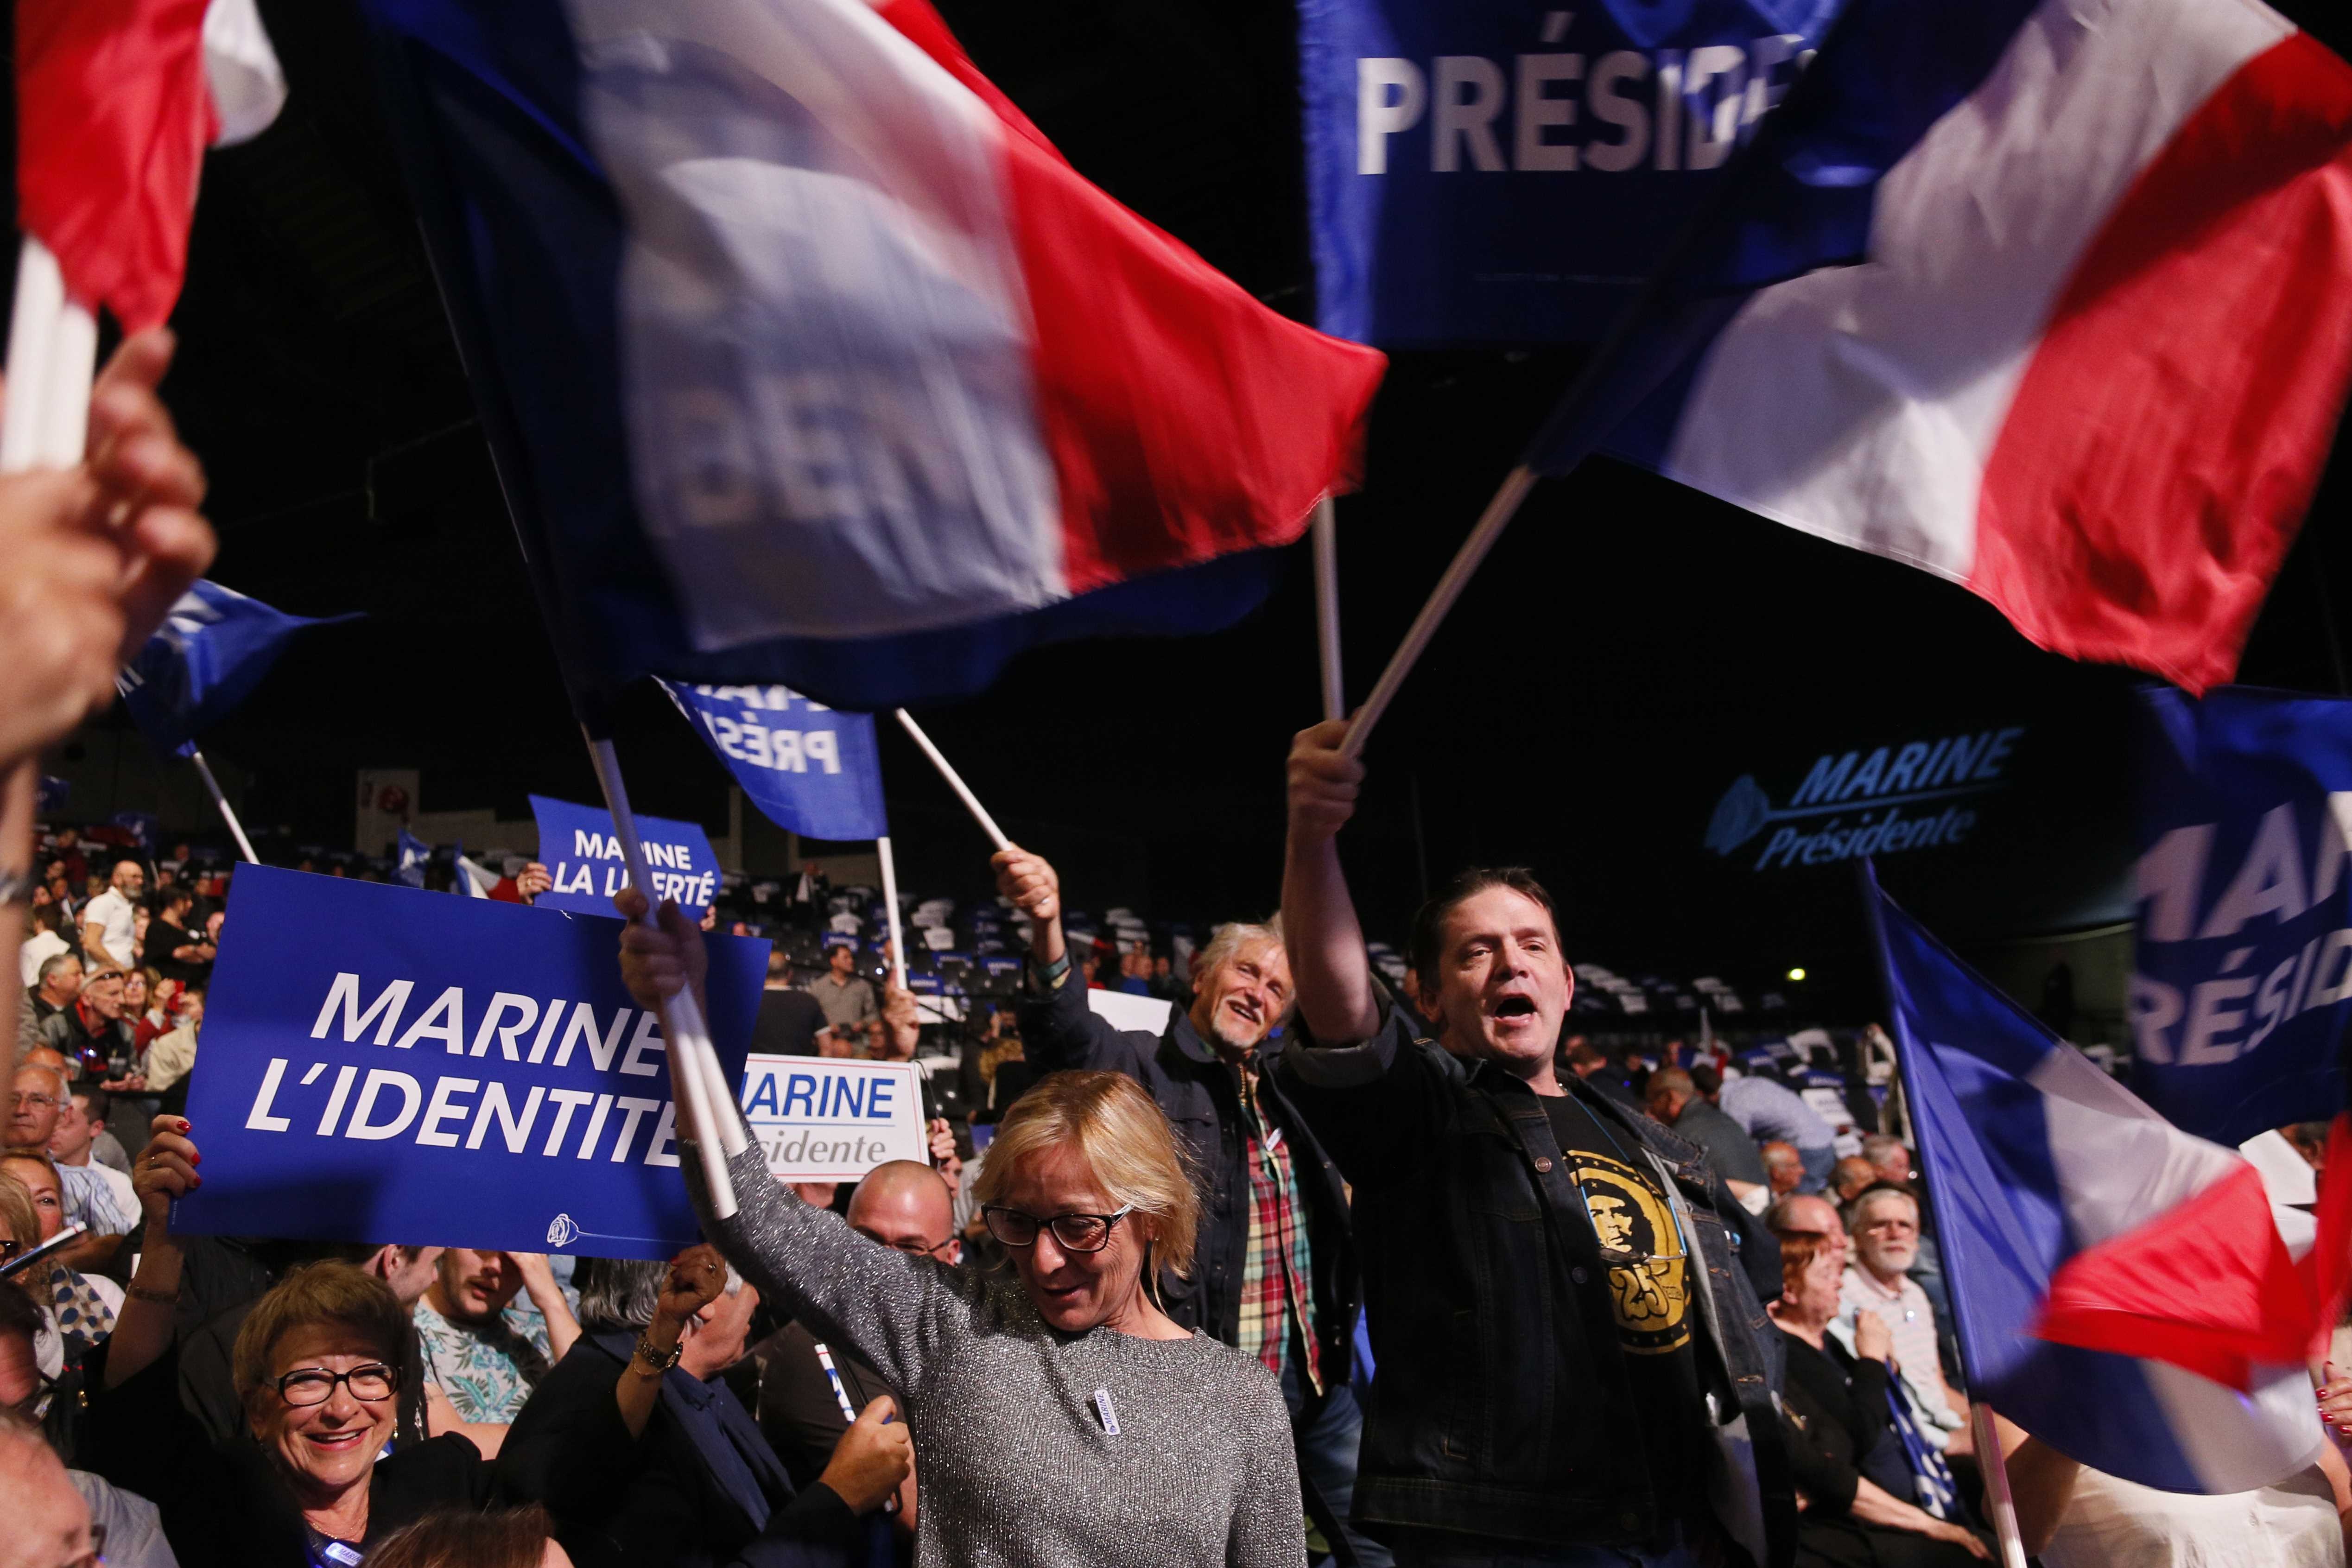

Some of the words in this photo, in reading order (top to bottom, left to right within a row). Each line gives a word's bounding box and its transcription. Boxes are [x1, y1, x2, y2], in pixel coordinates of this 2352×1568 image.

[1356, 10, 1818, 176] PRÉSIDE
[1788, 726, 2026, 807] MARINE
[575, 829, 692, 870] MAINE
[1754, 806, 1976, 872] Présidente
[552, 862, 594, 895] LA
[604, 866, 715, 907] LIERTÉ
[310, 972, 667, 1077] MARINE
[2128, 928, 2352, 1066] RÉSID
[759, 1130, 886, 1164] sidente
[1097, 1393, 1113, 1424] MARINE
